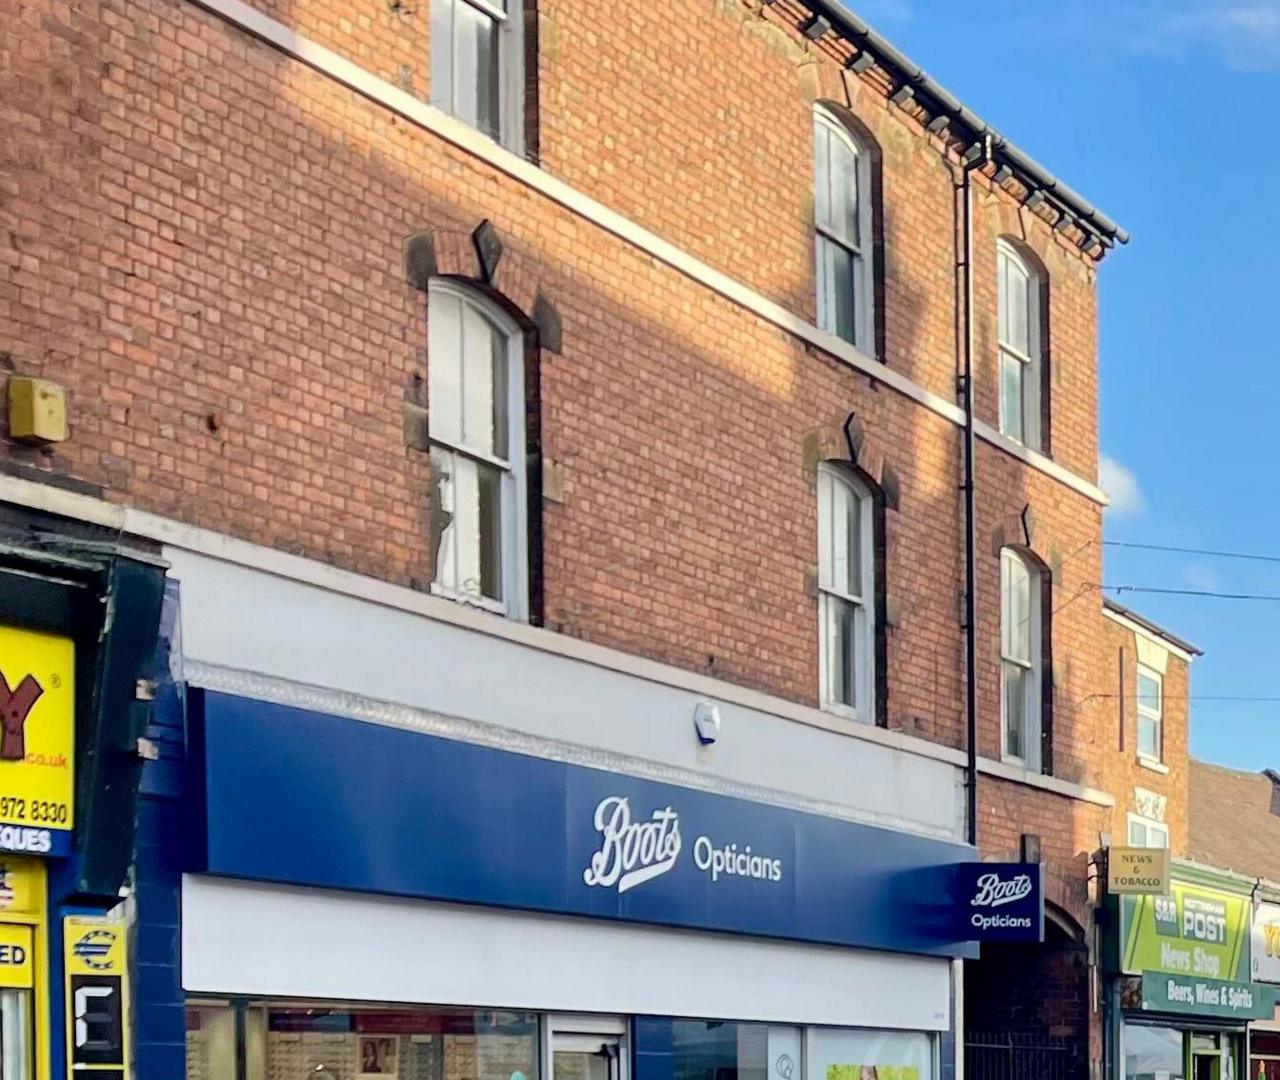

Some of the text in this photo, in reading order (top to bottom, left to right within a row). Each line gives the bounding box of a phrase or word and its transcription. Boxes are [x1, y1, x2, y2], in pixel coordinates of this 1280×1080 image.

[31, 800, 67, 824] 8330
[583, 795, 782, 894] Boots Opticians
[1121, 854, 1153, 864] NEWS
[1133, 866, 1141, 875] &
[970, 873, 1033, 908] Boots
[1113, 877, 1161, 888] TOBACCO
[970, 913, 1032, 930] Opticians
[1183, 910, 1226, 943] POST
[1160, 941, 1220, 978] News Shop
[1167, 980, 1253, 1011] Beers, Wines & Spirits
